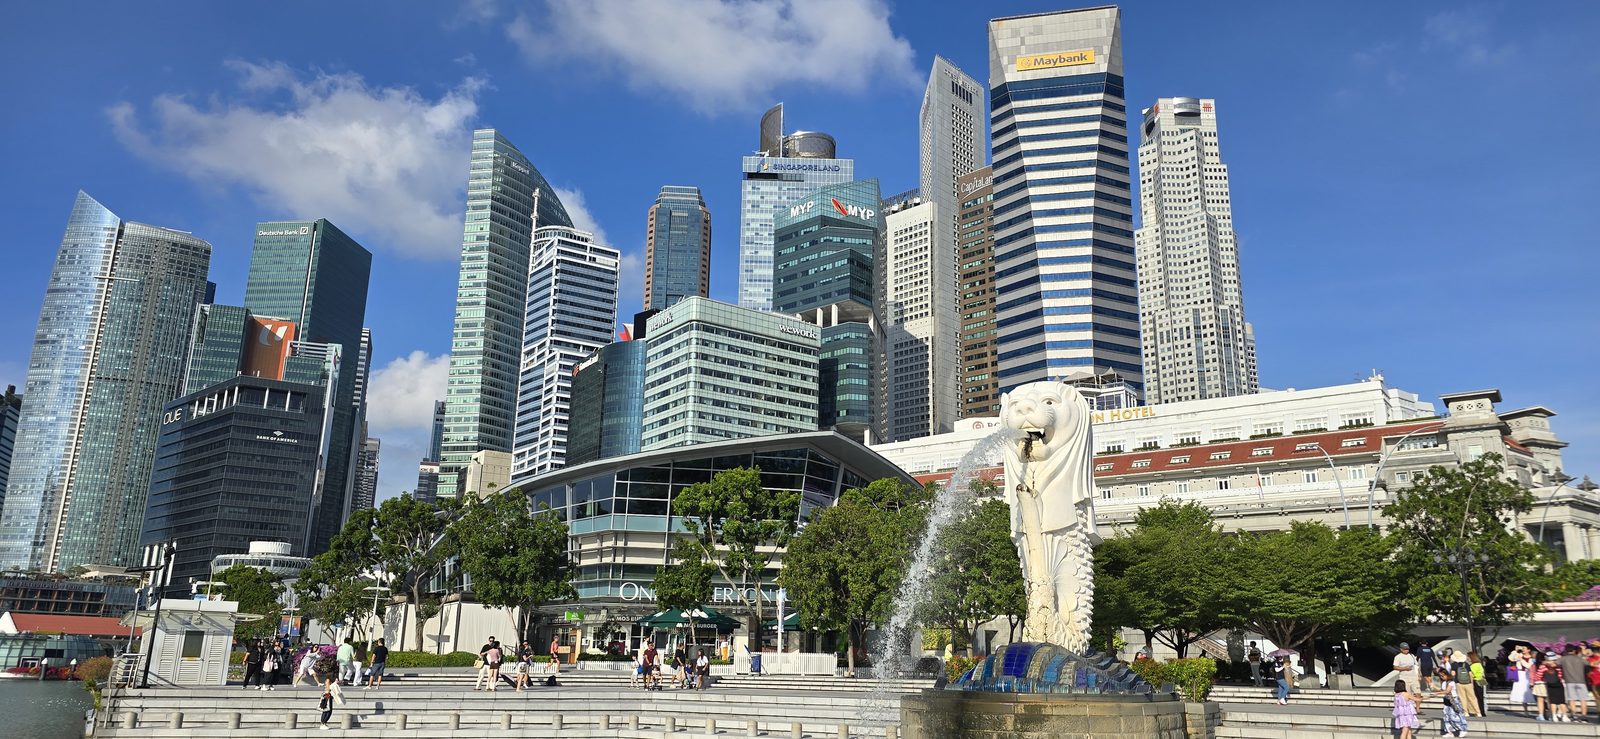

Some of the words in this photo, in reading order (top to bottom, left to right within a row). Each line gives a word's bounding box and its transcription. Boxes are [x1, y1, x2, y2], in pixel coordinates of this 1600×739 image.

[1033, 53, 1088, 66] Maybank
[773, 163, 841, 172] SINGAPORELAND
[790, 200, 814, 218] MYP
[848, 204, 875, 221] MYP
[163, 408, 183, 425] OUE
[1110, 406, 1156, 421] HOTEL
[619, 582, 657, 602] ON
